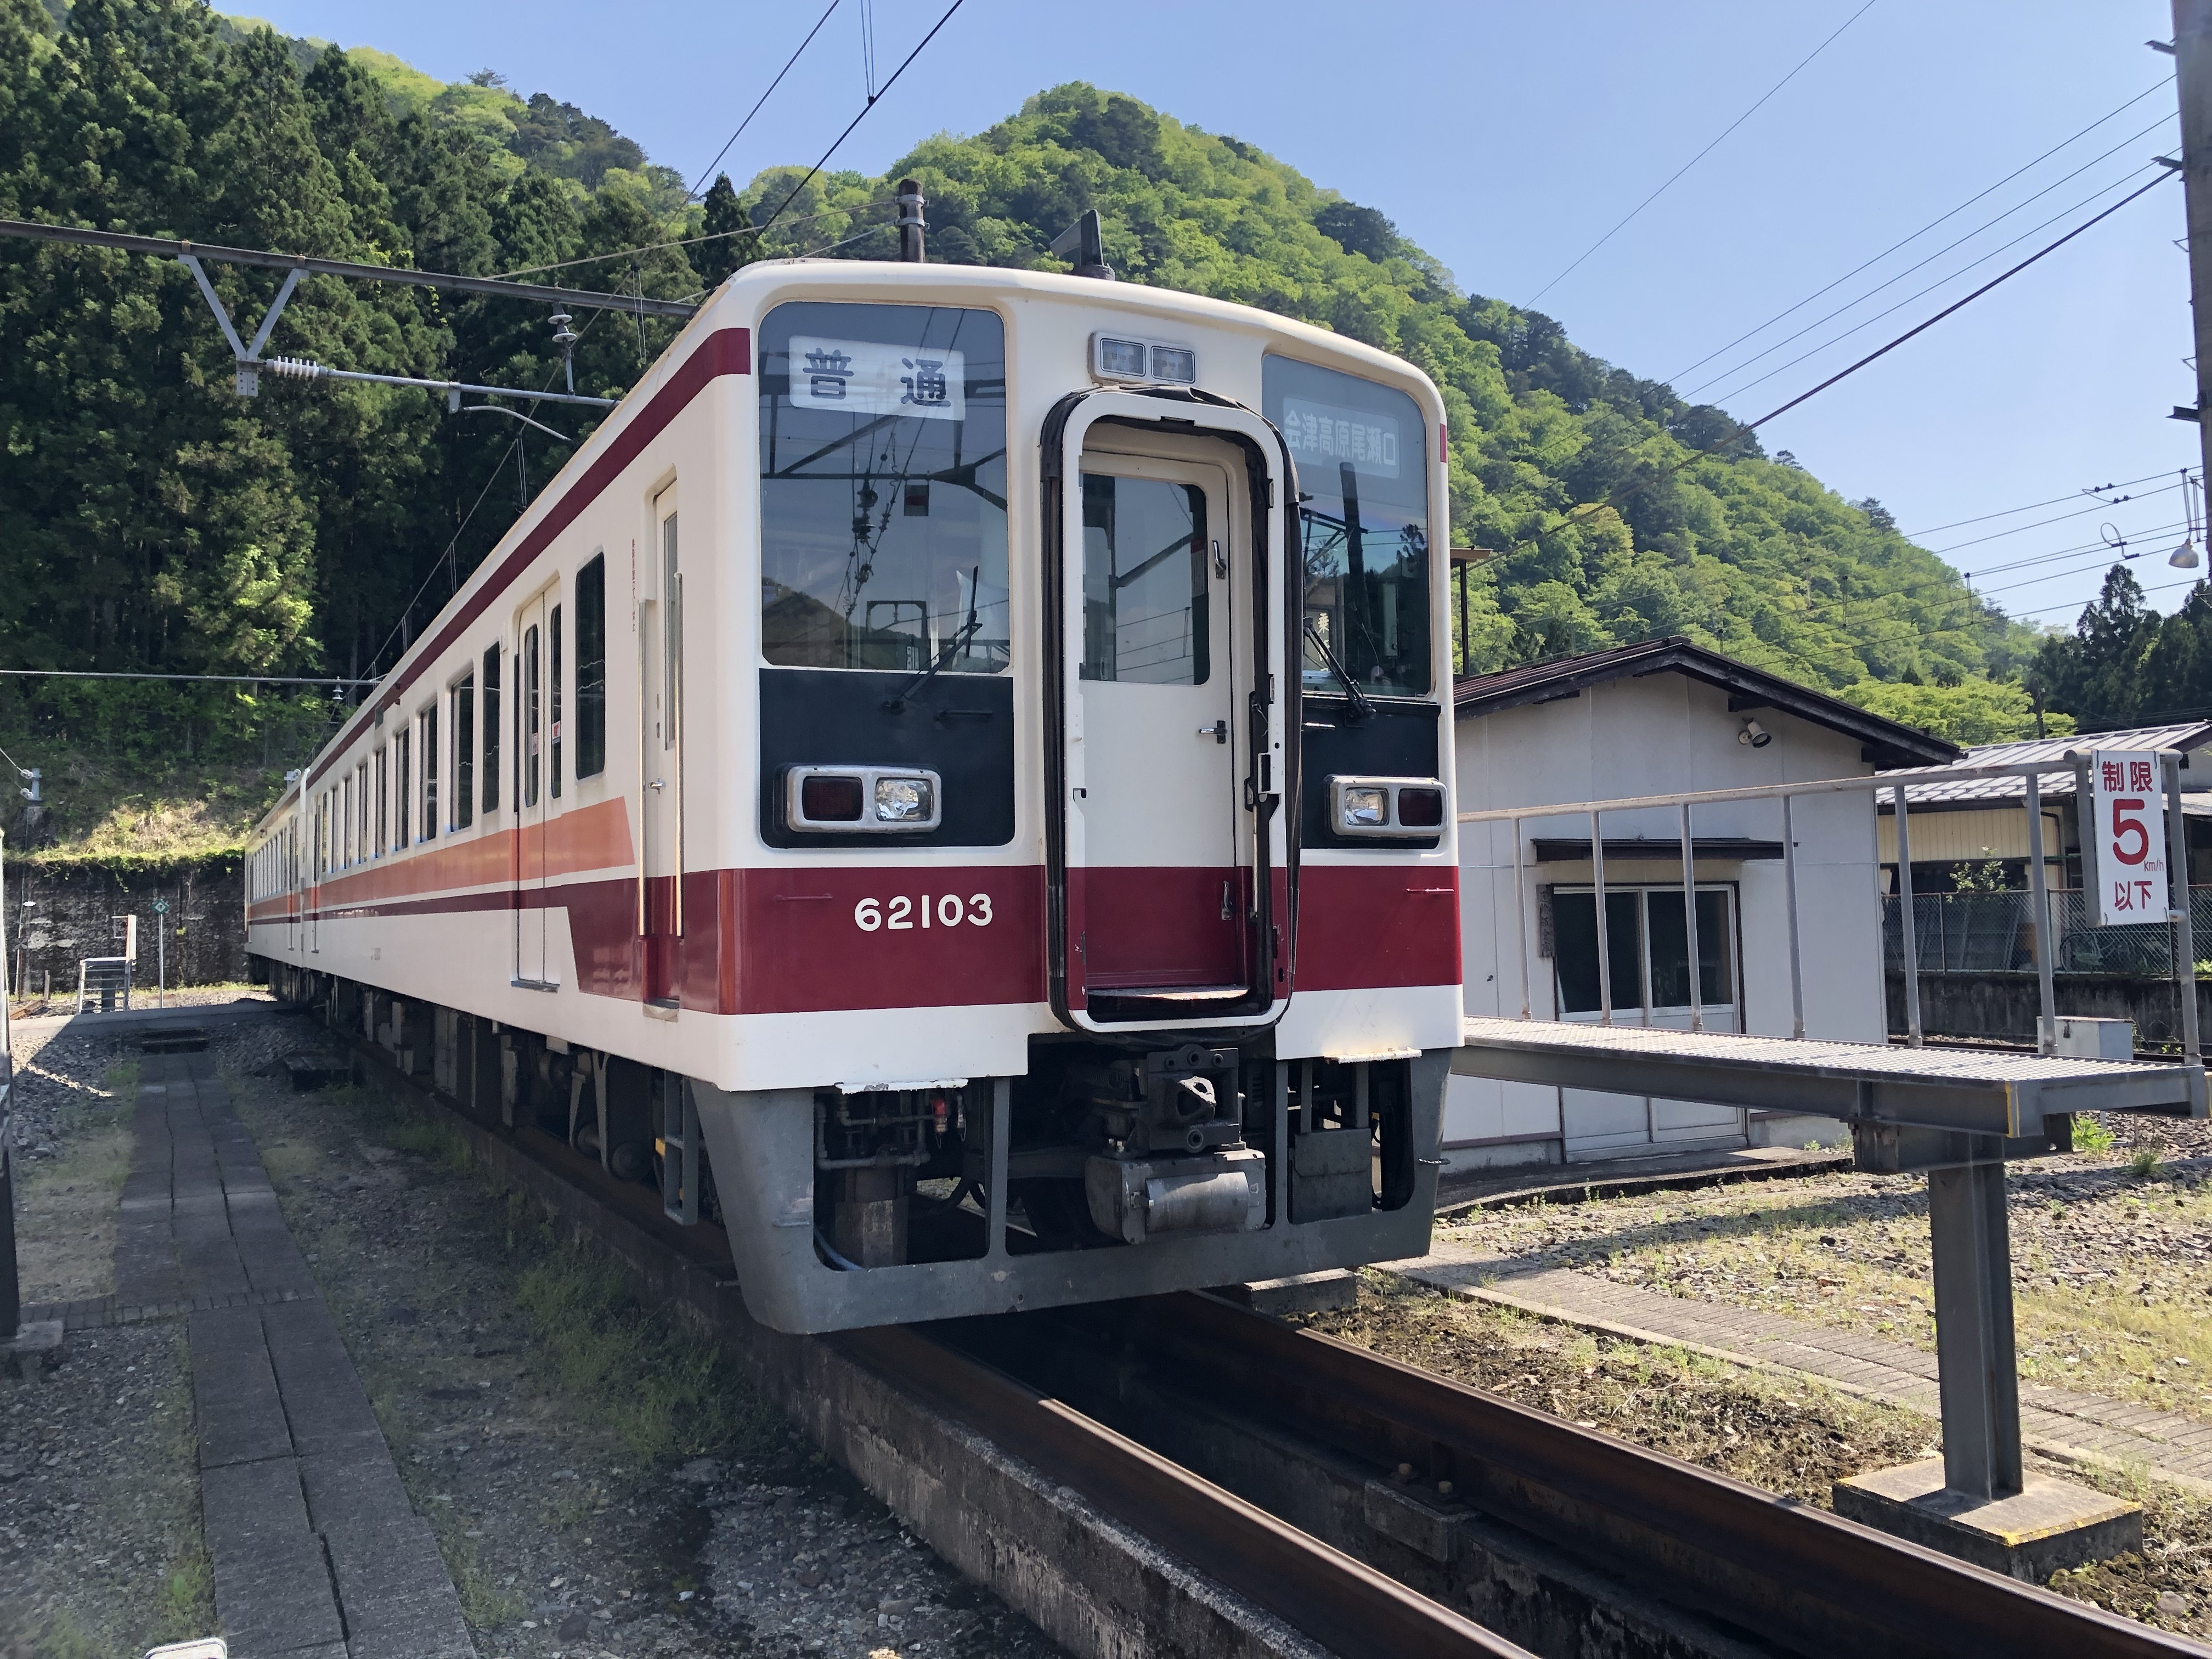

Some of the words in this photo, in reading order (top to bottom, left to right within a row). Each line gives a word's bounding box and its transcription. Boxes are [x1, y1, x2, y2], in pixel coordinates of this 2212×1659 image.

[802, 347, 951, 408] 普通
[1284, 409, 1396, 466] 会津高原尾瀬口
[2102, 760, 2153, 792] 制限
[2113, 799, 2149, 865] 5
[2143, 857, 2164, 872] km/h
[854, 893, 993, 932] 62103
[2114, 881, 2153, 911] 以下
